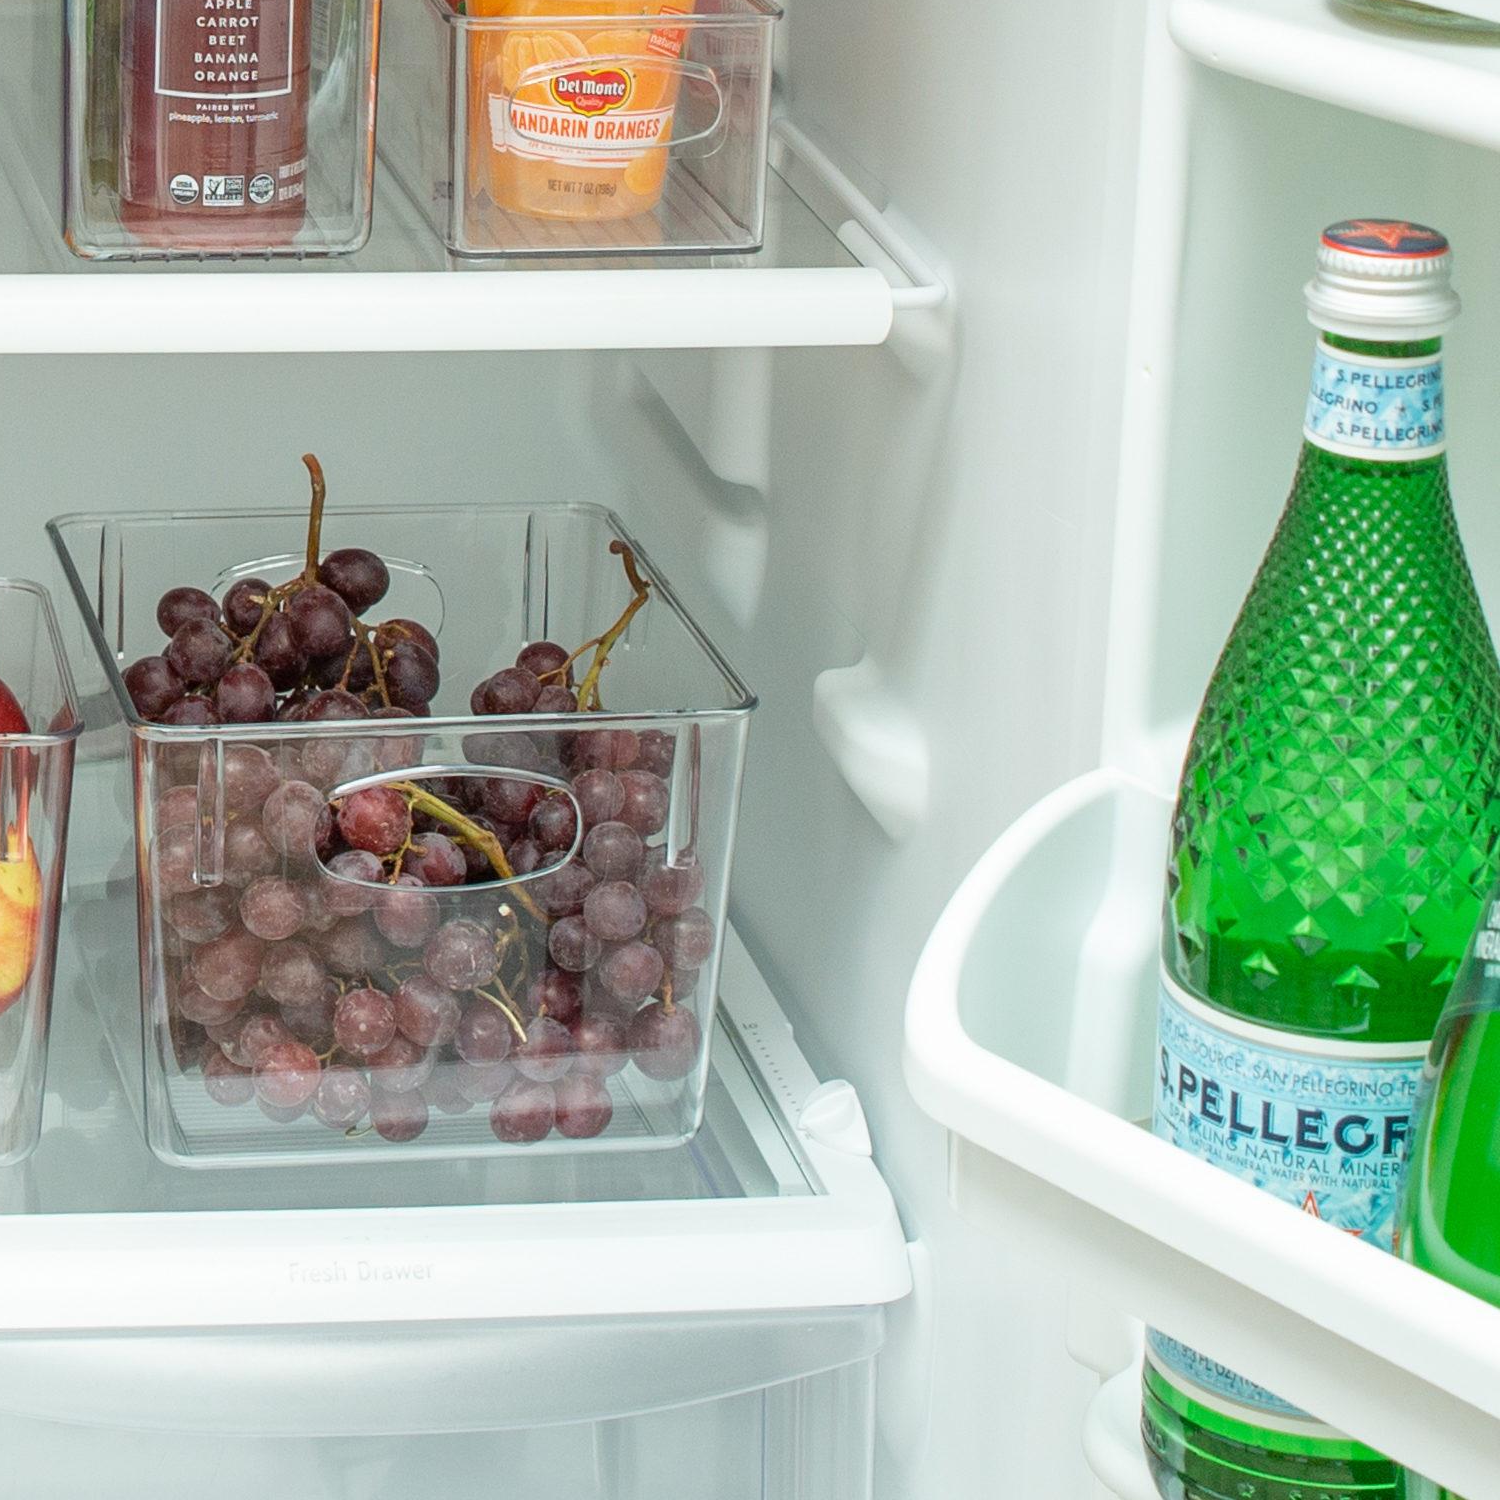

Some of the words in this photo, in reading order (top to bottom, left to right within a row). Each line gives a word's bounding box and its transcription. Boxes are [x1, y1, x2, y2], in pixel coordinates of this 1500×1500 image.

[204, 0, 253, 10] APPLE
[196, 16, 260, 28] CARROT
[208, 35, 247, 46] BEET
[194, 52, 260, 64] BANANA
[194, 70, 260, 82] ORANGE
[558, 77, 580, 94] Del
[582, 81, 626, 96] Monte
[196, 103, 230, 111] PAIRED
[232, 103, 256, 111] WITH
[168, 111, 213, 125] pineapple,
[214, 113, 245, 125] lemon,
[512, 109, 589, 139] MANDARIN
[594, 118, 661, 140] ORANGES
[548, 179, 562, 192] NET
[564, 181, 577, 193] WT
[1336, 367, 1441, 389] S.PELLEGRIN
[1336, 421, 1442, 441] S.PELLEGRIN
[1252, 1063, 1289, 1087] SAN
[1292, 1074, 1394, 1097] PELLEGRINO
[1160, 1045, 1410, 1158] S.PELLEG
[1169, 1102, 1238, 1151] SPARKLING
[1245, 1143, 1331, 1175] NATURAL
[1225, 1152, 1267, 1172] MINERAL
[1270, 1165, 1304, 1182] WATER
[1308, 1174, 1338, 1188] WITH
[1341, 1176, 1393, 1190] NATURAL
[288, 1261, 347, 1283] Fresh
[357, 1260, 435, 1282] Drawer
